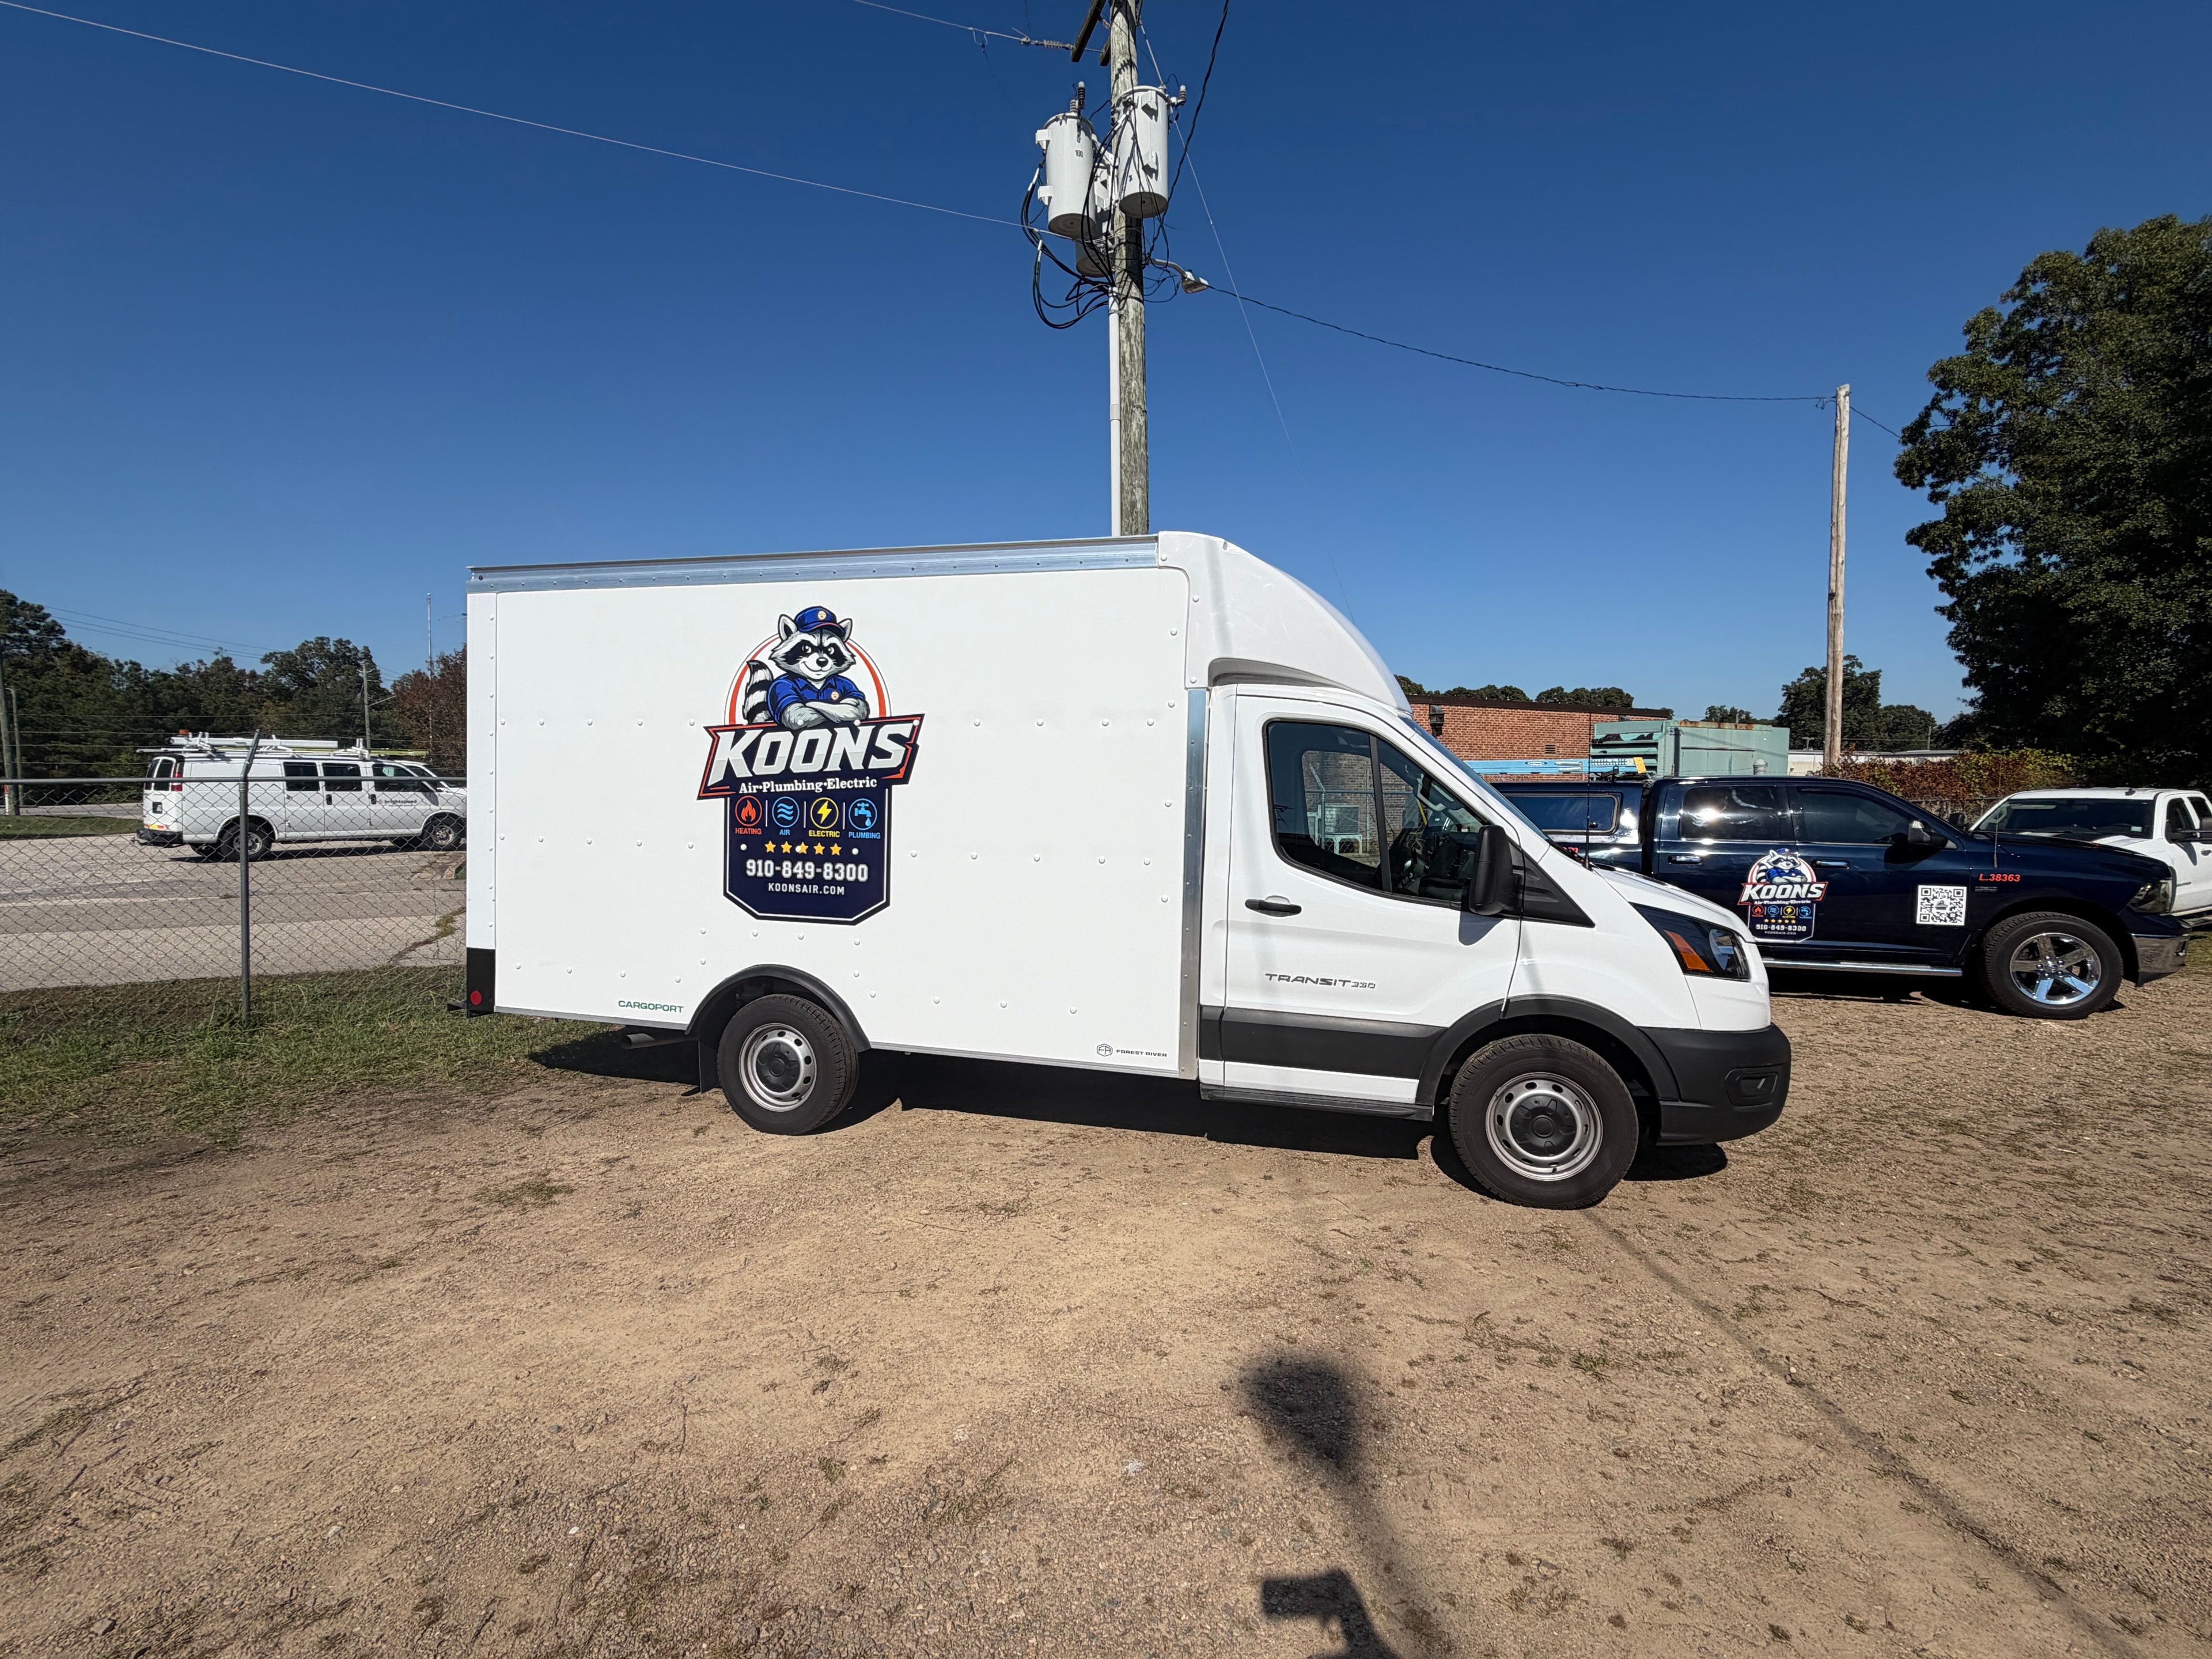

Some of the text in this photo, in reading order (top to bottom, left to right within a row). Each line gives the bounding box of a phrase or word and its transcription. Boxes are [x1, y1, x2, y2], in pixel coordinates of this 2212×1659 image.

[707, 724, 912, 786] KOONS
[809, 830, 840, 838] ELECTRIC
[849, 831, 881, 839] PLUMBING
[746, 859, 869, 882] 910-849-8300
[1979, 873, 2021, 882] L.38363
[768, 882, 844, 895] KOONSAIR.COM
[1741, 884, 1825, 902] KOONS
[1265, 973, 1351, 987] TRANSIT
[618, 1000, 684, 1013] CARGOPORT
